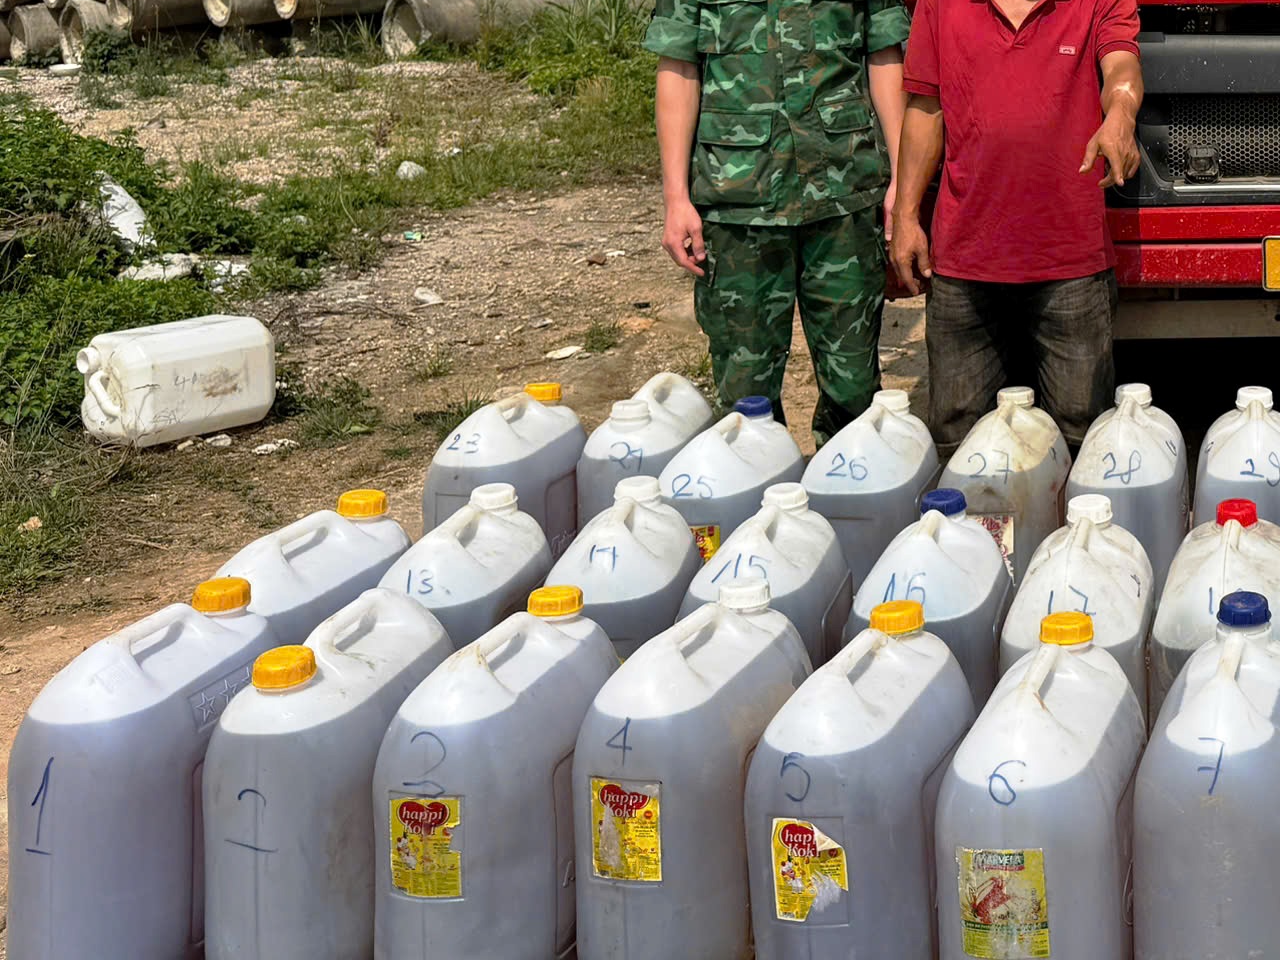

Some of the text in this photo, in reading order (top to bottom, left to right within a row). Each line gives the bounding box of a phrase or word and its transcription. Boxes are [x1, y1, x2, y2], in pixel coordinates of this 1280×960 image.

[826, 453, 868, 481] 26
[968, 449, 1013, 485] 27
[1103, 449, 1142, 485] 28
[672, 473, 716, 500] 25
[606, 717, 633, 767] 4
[780, 752, 811, 802] 5
[988, 760, 1027, 806] 6
[1197, 737, 1225, 796] 7
[25, 756, 54, 856] 1
[402, 806, 443, 823] happi
[603, 789, 644, 807] happi
